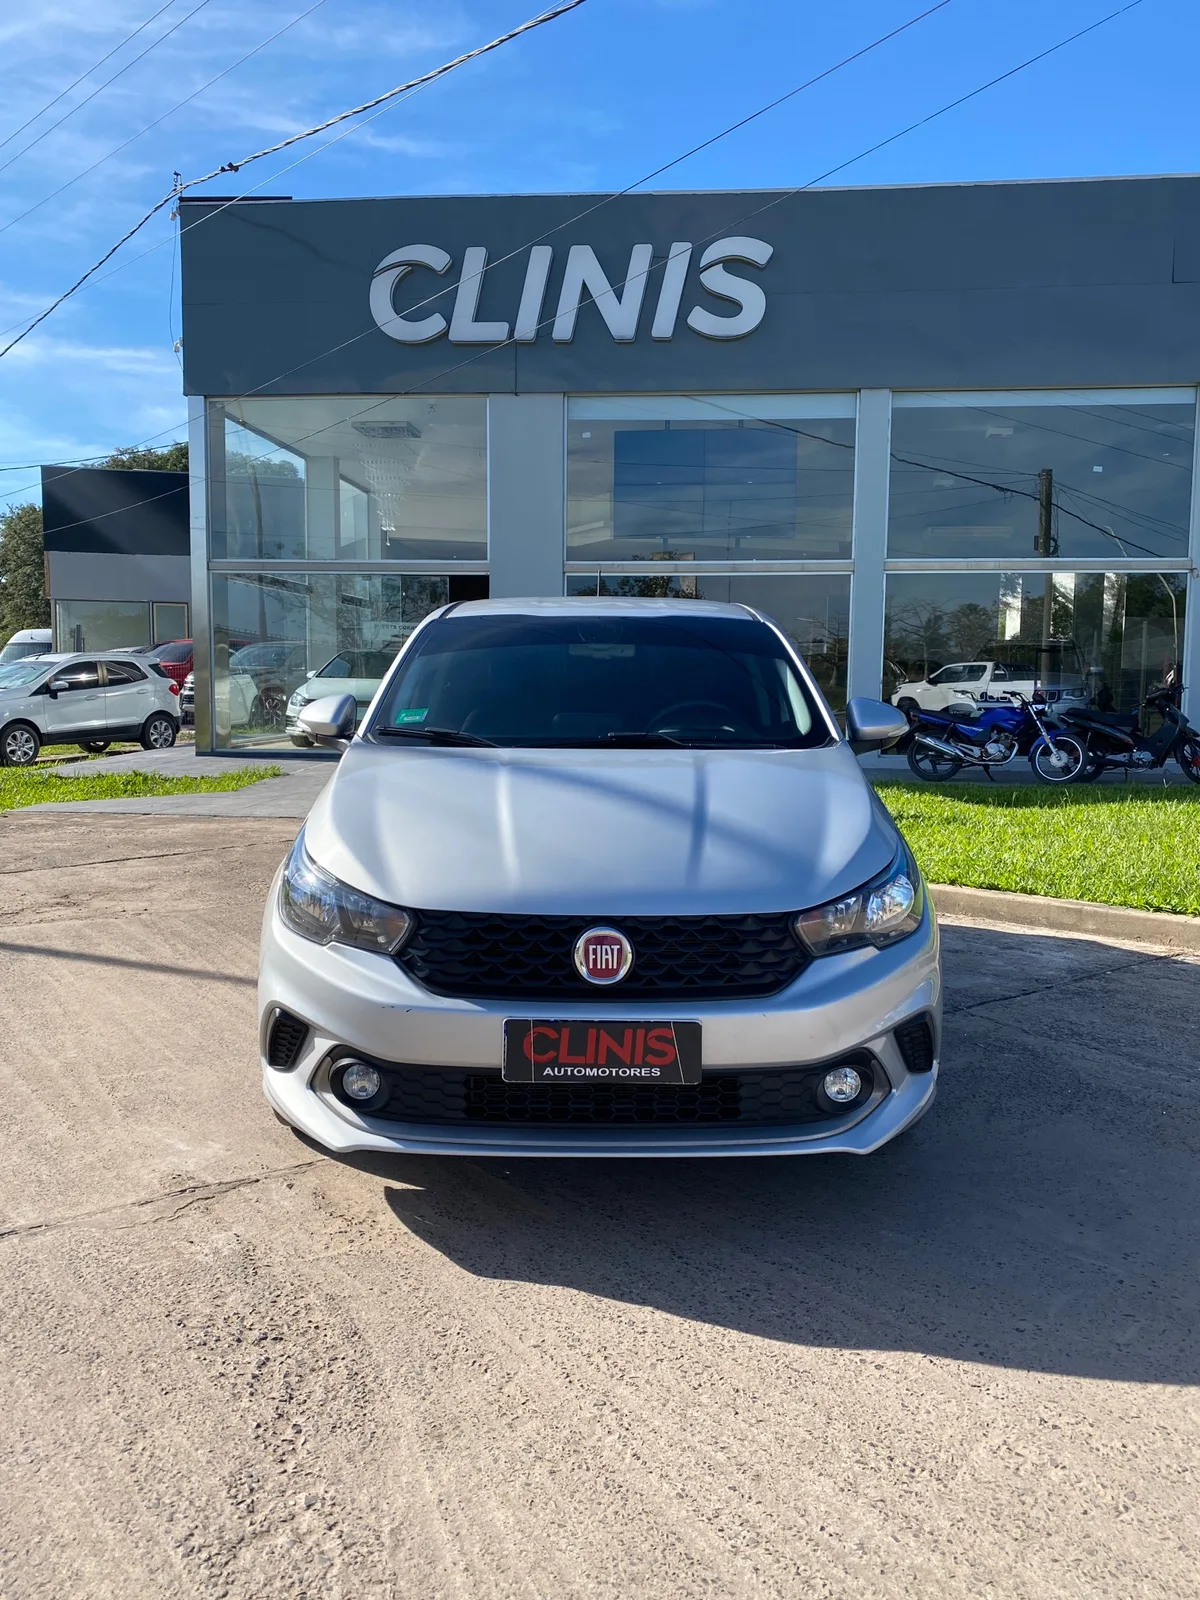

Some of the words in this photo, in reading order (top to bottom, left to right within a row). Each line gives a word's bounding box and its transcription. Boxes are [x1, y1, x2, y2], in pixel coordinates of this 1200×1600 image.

[369, 235, 774, 345] CLINIS
[589, 944, 620, 969] FIAT
[522, 1026, 677, 1066] CLINIS
[542, 1067, 661, 1077] AUTOMOTORES
